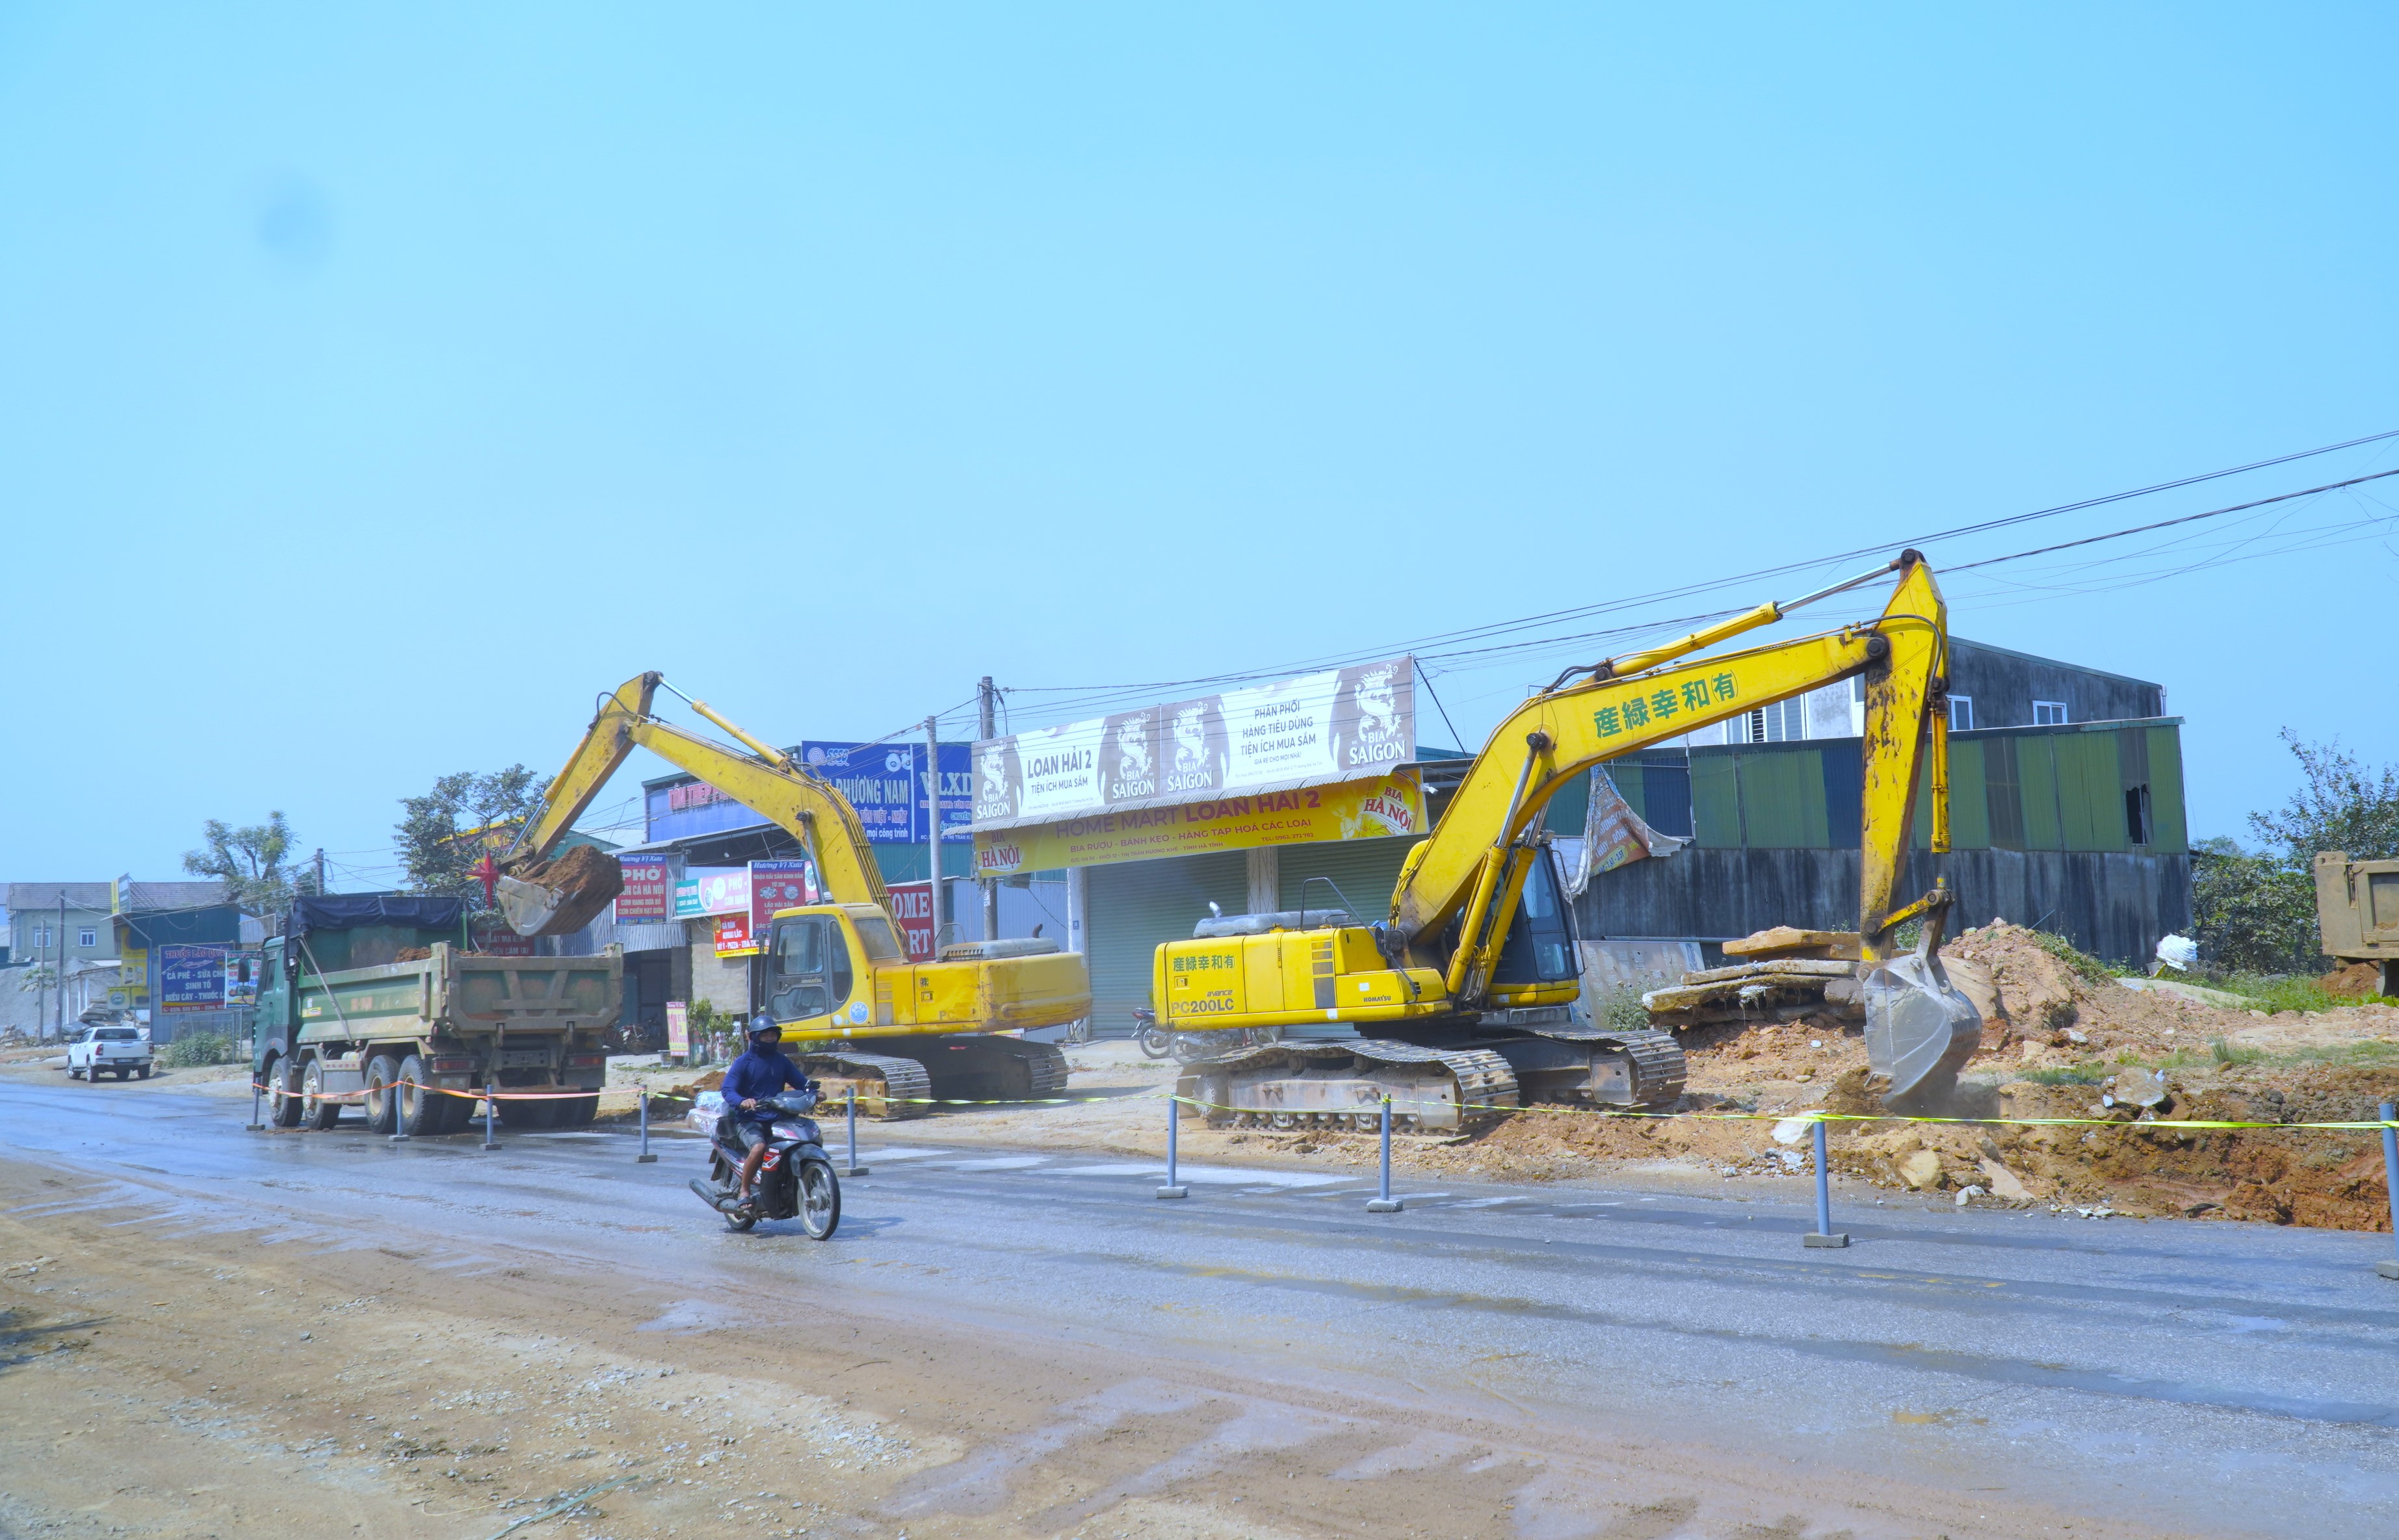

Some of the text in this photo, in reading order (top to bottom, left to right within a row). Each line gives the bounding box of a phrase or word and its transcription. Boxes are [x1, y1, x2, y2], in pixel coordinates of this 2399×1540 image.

[1255, 698, 1300, 720] PHÂN PHỐI
[1242, 716, 1313, 738] HÀNG TIÊU DÙNG
[1368, 731, 1385, 743] BIA
[1240, 731, 1316, 759] TIỆN ÍCH MUA SẮM
[1349, 740, 1406, 765] SAIGON
[1028, 746, 1092, 778] LOAN HẢI 2
[1183, 761, 1196, 772] BIA
[1126, 770, 1140, 780] BIA
[1168, 770, 1213, 792] SAIGON
[885, 779, 908, 804] NAM
[1031, 776, 1088, 796] TIỆN ÍCH MUA SẮM
[1112, 779, 1155, 800] SAIGON
[1383, 786, 1402, 803] BIA
[988, 792, 999, 802] BIA
[860, 807, 873, 823] TÔN
[977, 801, 1011, 820] SAIGON
[1056, 815, 1115, 839] HOME
[1121, 807, 1179, 831] MART
[1186, 799, 1250, 822] LOAN
[1305, 790, 1321, 808] 2
[1363, 796, 1412, 831] HÀ NỘI
[878, 828, 895, 840] công
[1088, 841, 1112, 851] RƯỢU
[1121, 838, 1146, 846] BÁNH
[1150, 835, 1170, 844] KẸO
[1179, 828, 1209, 840] HÀNG
[1211, 828, 1231, 837] TẠP
[1235, 822, 1259, 833] HOÁ
[1262, 819, 1284, 830] CÁC
[1287, 819, 1311, 828] LOẠI
[981, 844, 1021, 868] HÀ NỘI
[621, 865, 661, 881] PHỞ
[892, 893, 930, 920] OME
[908, 929, 930, 954] RT
[177, 969, 191, 980] PHÊ
[185, 979, 211, 990] SINH TỐ
[1171, 998, 1235, 1014] PC200LC
[1363, 995, 1391, 1003] KOMATSU
